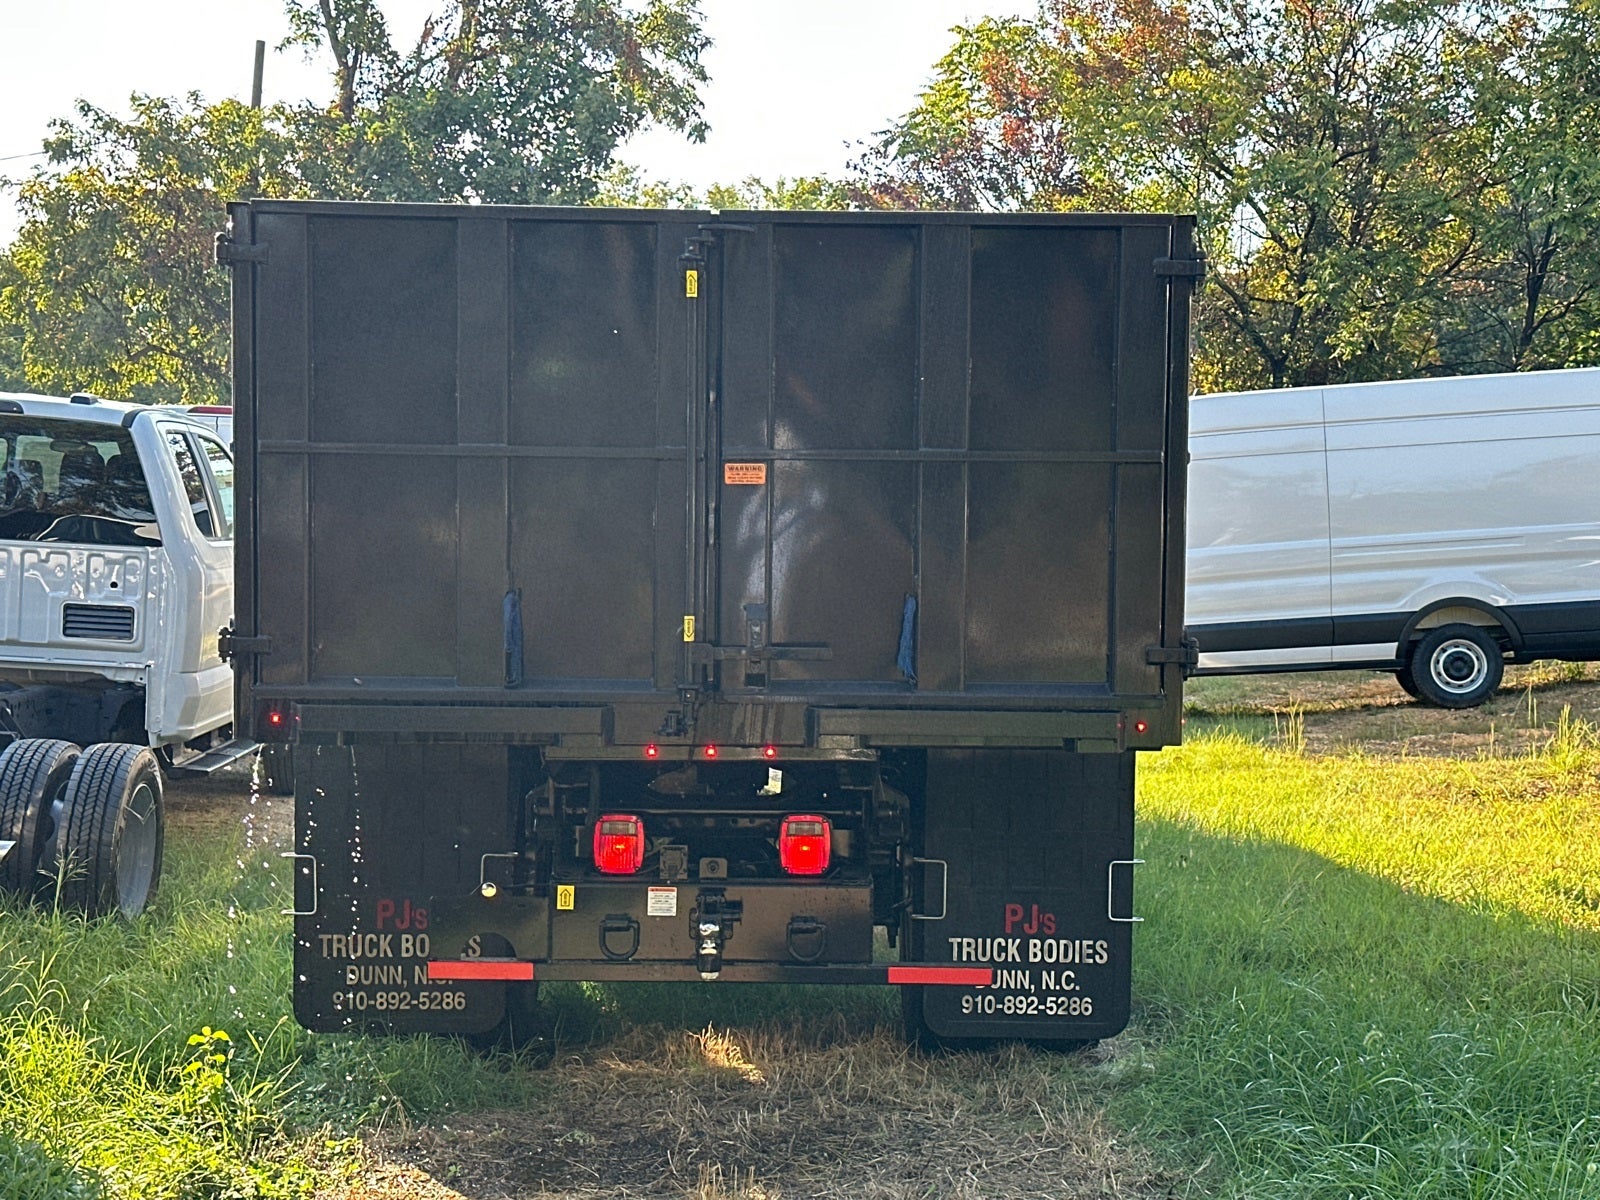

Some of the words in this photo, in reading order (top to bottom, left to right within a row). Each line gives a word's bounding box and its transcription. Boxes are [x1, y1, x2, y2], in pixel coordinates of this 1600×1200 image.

[318, 934, 393, 958] TRUCK
[402, 934, 481, 958] BOS
[949, 937, 1021, 962] TRUCK
[1028, 939, 1108, 964] BODIES
[346, 965, 408, 988] DUNN,
[975, 969, 1035, 993] UNN,
[1041, 970, 1080, 990] N.C.
[332, 992, 466, 1010] 910-892-5286
[961, 995, 1093, 1016] 910-892-5286
